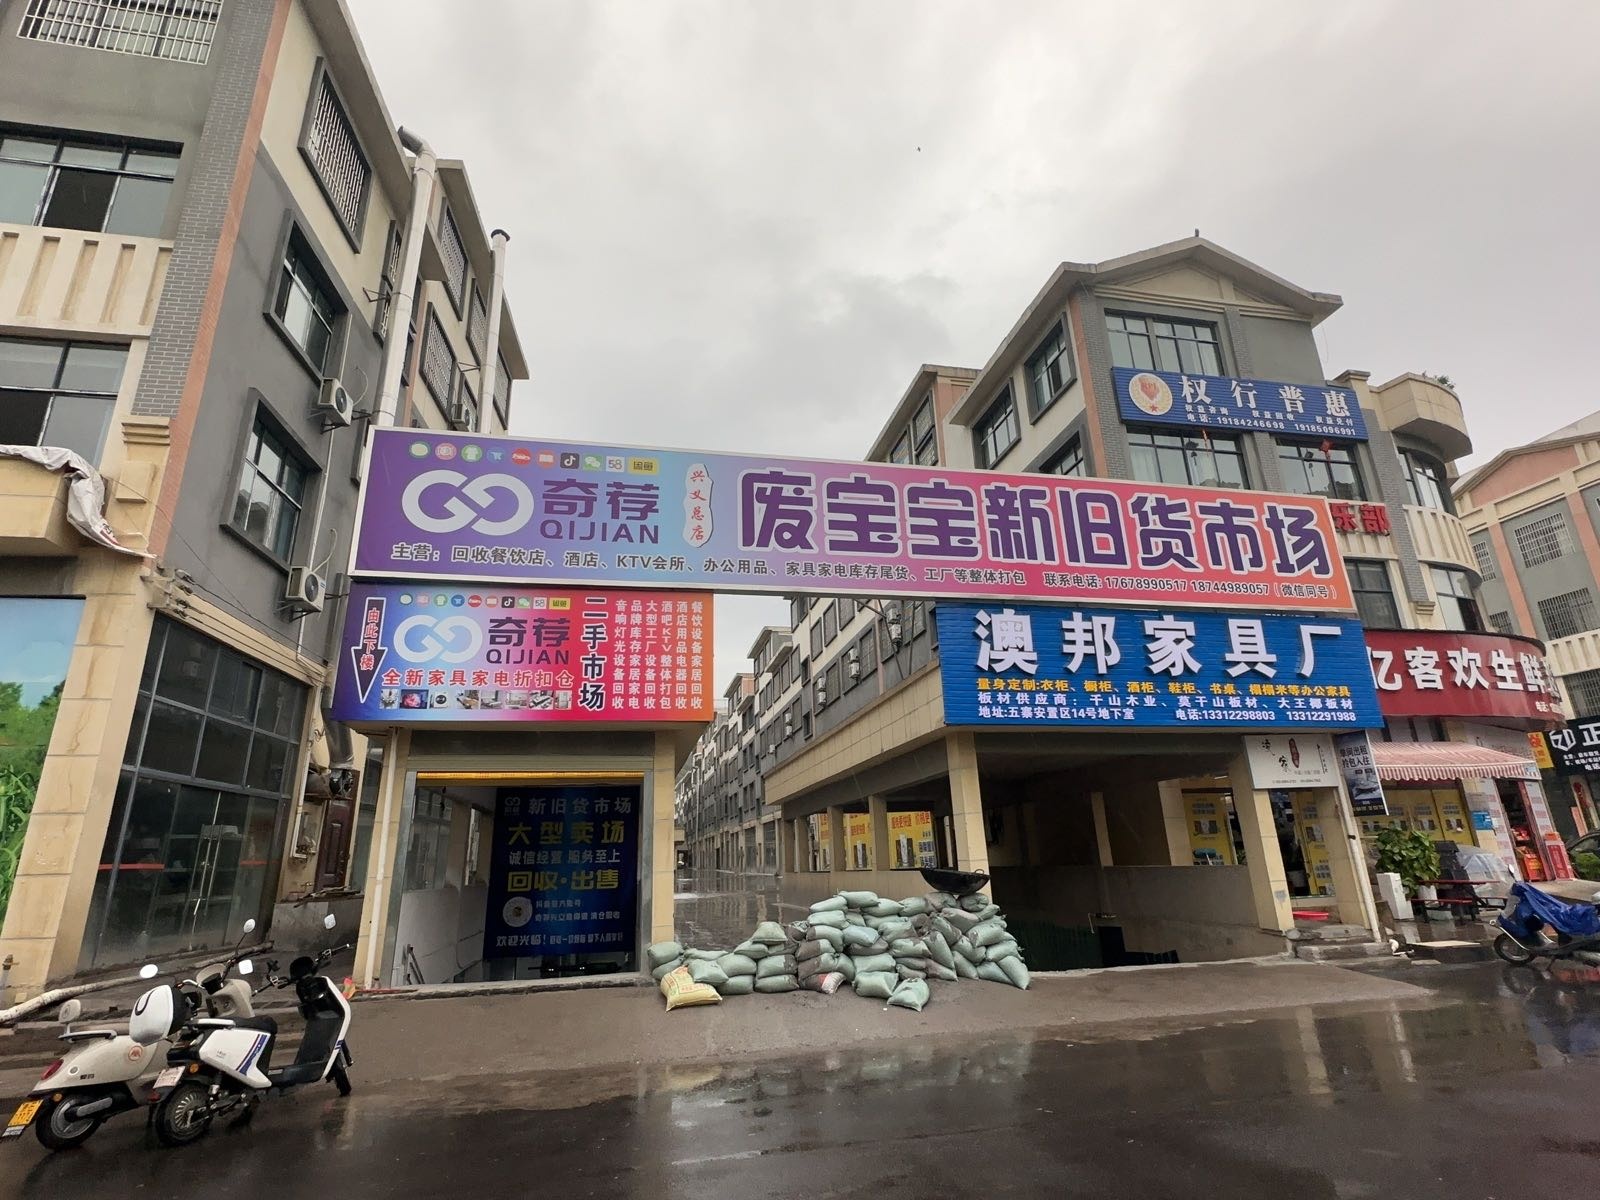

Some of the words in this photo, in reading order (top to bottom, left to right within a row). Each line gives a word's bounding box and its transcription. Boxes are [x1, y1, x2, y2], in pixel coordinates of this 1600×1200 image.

[1179, 375, 1350, 417] 权行普惠
[1217, 417, 1286, 430] 19184246698
[1294, 423, 1357, 436] 19185096991
[608, 459, 623, 471] 58
[542, 478, 660, 520] 奇荐
[540, 519, 660, 545] QIJIAN
[740, 467, 1332, 577] 废宝宝新旧货市场
[1105, 576, 1188, 592] 17678990517
[1191, 580, 1270, 596] 18744989057
[360, 607, 380, 671] 由此下楼
[488, 616, 570, 647] 奇荐
[974, 608, 1342, 678] 澳邦家具厂
[486, 649, 570, 665] QIJIAN
[578, 597, 608, 711] 二手市场
[612, 599, 627, 709] 音响灯光设备回收
[628, 600, 642, 709] 品牌库存家居家电
[644, 600, 657, 709] 大型工厂设备回收
[660, 601, 673, 709] 酒吧KTV整体打包
[675, 601, 688, 709] 酒店用品电器回收
[691, 601, 704, 709] 餐饮设备家居回收
[1366, 646, 1559, 699] 亿客欢生鲜
[380, 667, 575, 689] 全新家具家电折扣仓
[1286, 710, 1357, 721] 13312291988
[528, 797, 632, 815] 新旧货市场
[507, 820, 626, 846] 大型卖场
[509, 849, 562, 865] 诚信经营
[567, 848, 621, 864] 服务至上
